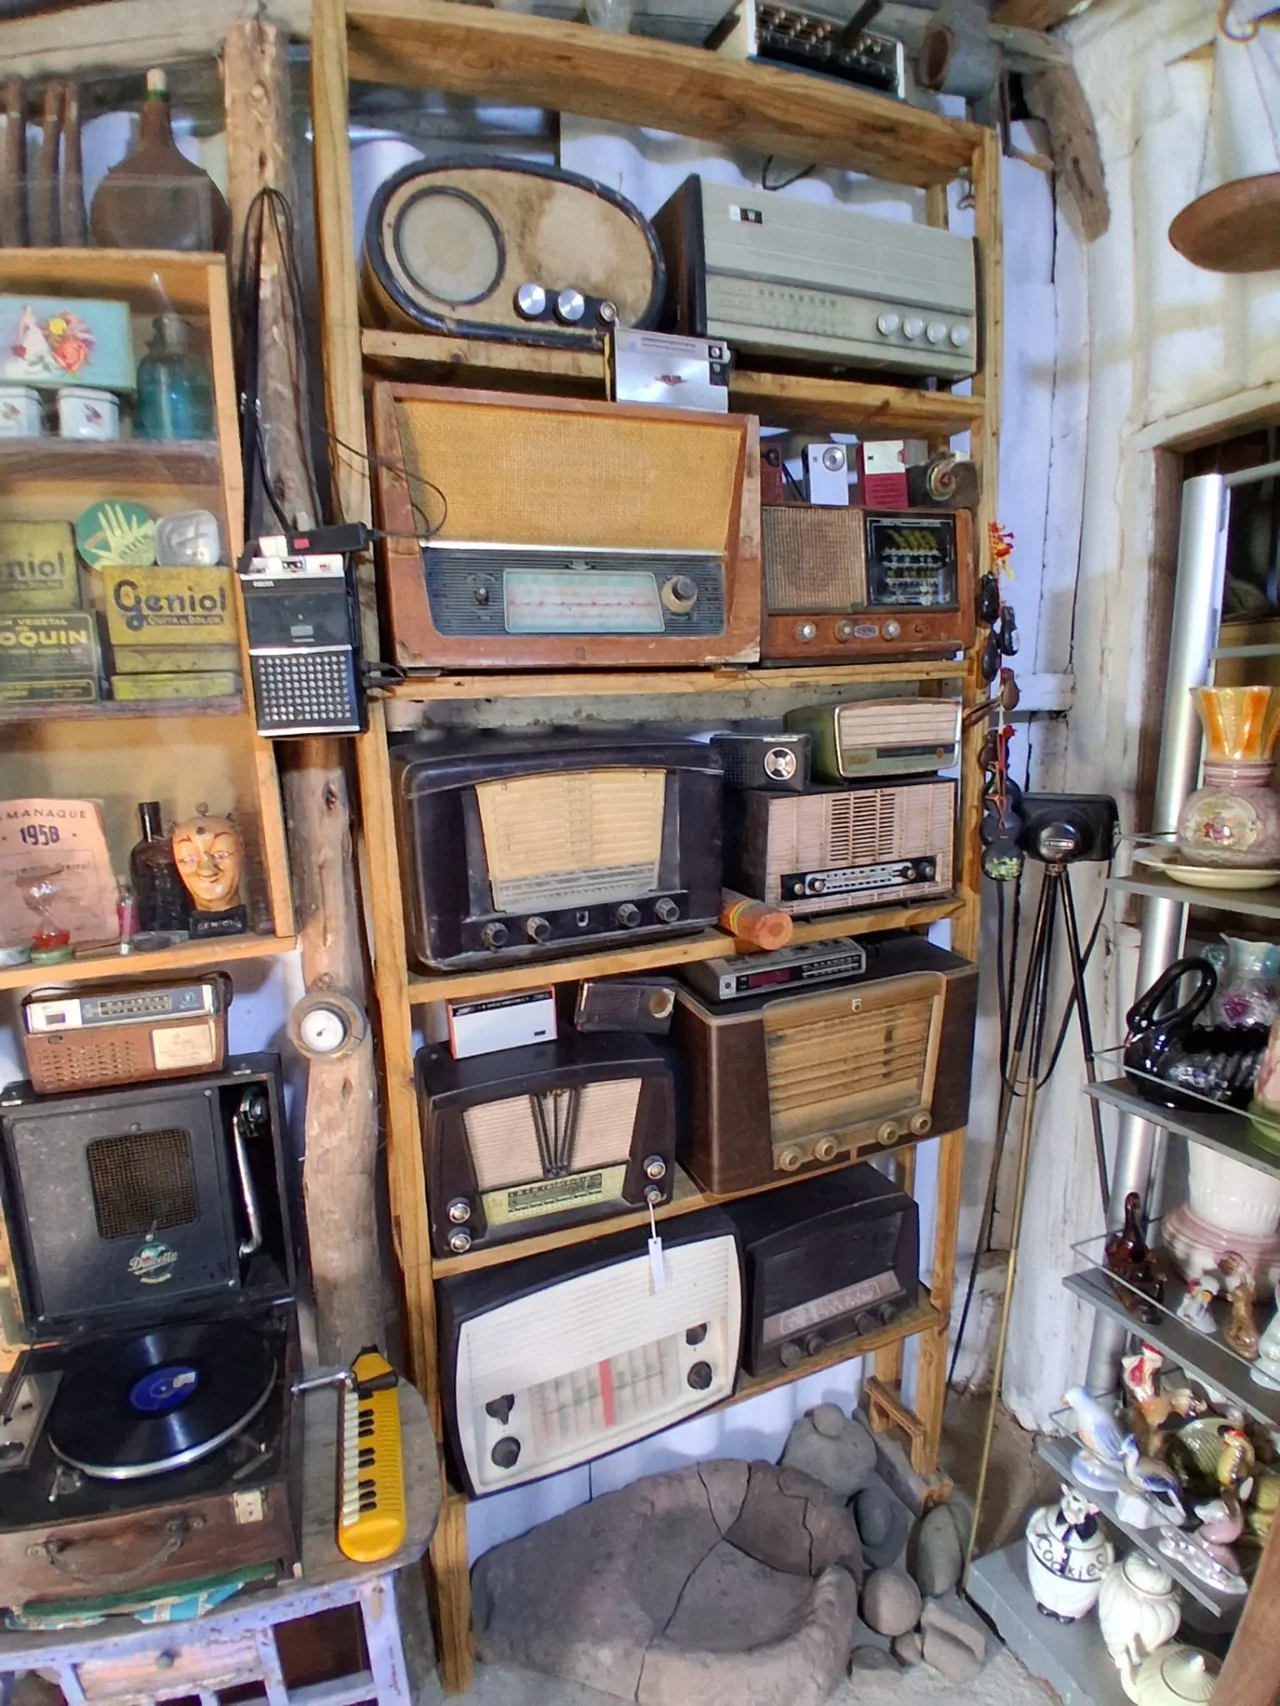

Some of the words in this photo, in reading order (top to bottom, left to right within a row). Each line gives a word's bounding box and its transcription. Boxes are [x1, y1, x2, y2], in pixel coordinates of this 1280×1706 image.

[0, 551, 64, 578] niol
[114, 579, 226, 632] Geniol
[20, 823, 60, 846] 1958
[1037, 1536, 1106, 1580] Cookies
